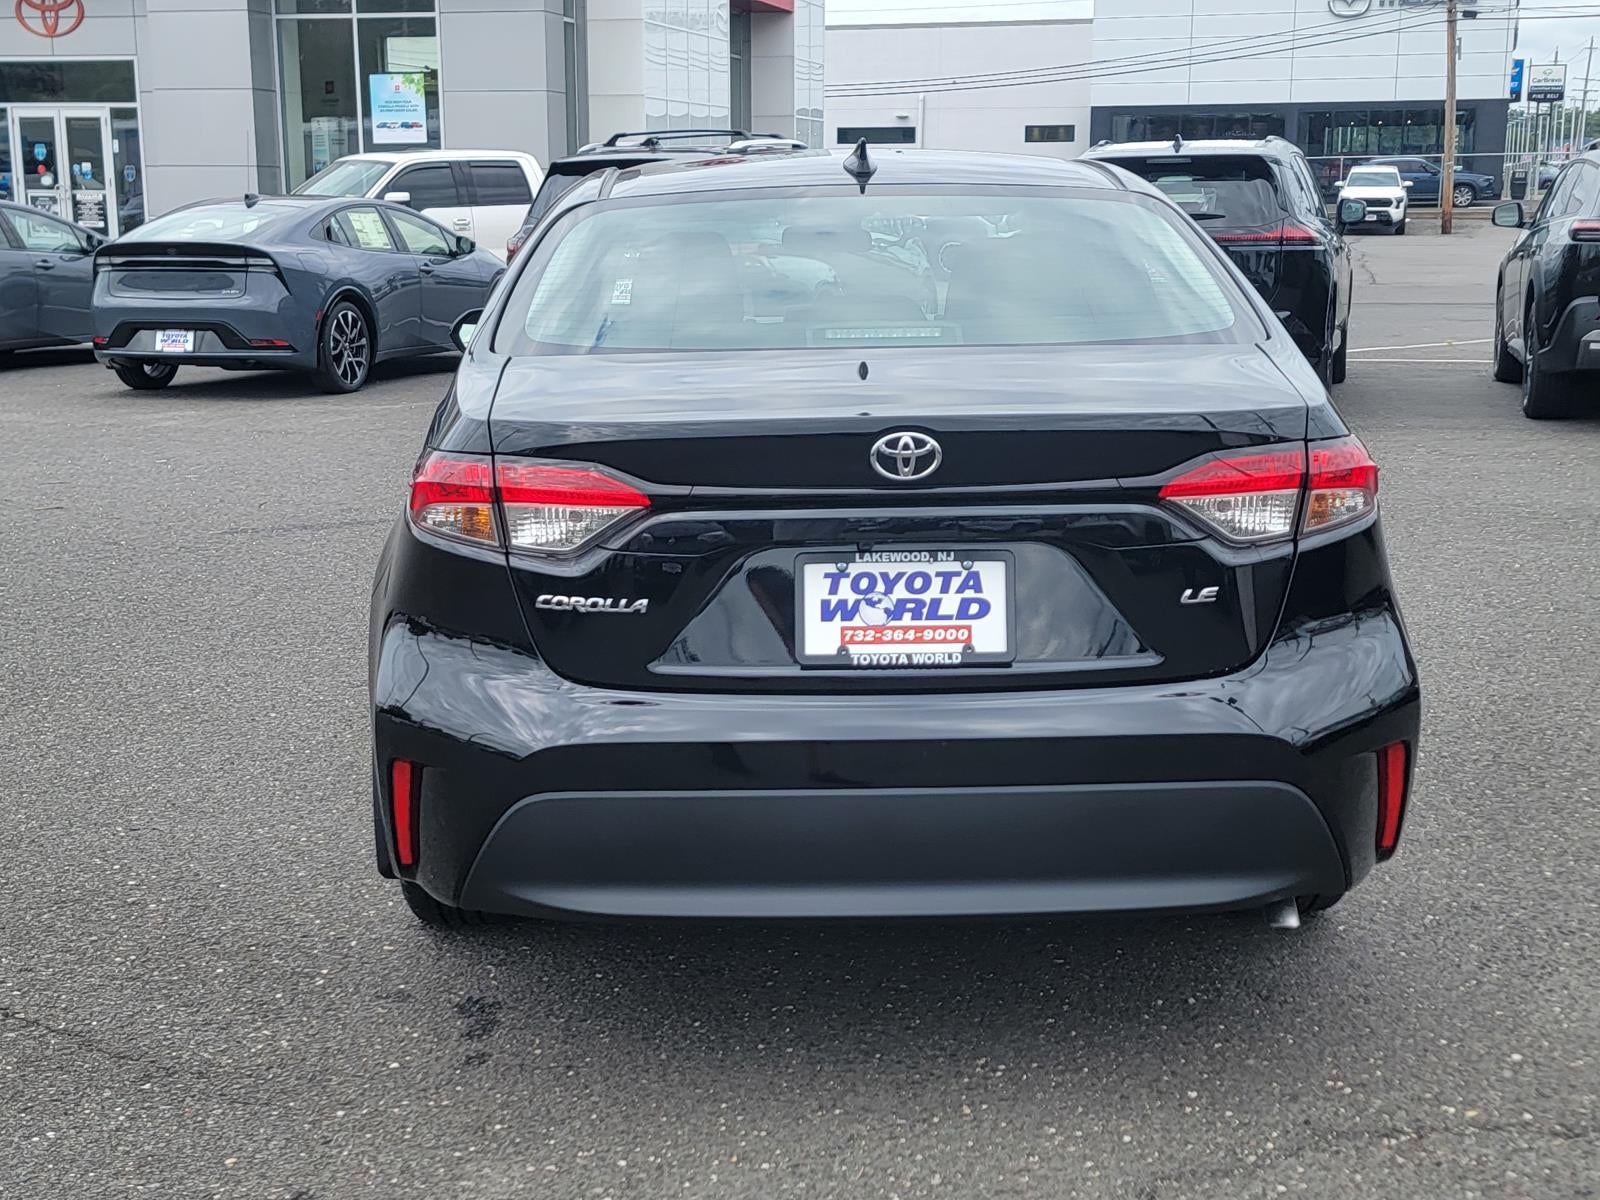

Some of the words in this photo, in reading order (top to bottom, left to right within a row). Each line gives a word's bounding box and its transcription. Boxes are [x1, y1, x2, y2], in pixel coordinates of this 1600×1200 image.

[855, 551, 934, 563] LAKEWOOD,
[937, 551, 955, 562] NJ
[823, 570, 984, 595] TOYOTA
[1180, 586, 1220, 604] LE
[535, 594, 649, 614] COROLLA
[843, 628, 969, 642] 732-364-9000
[852, 653, 909, 665] TOYOTA
[912, 652, 962, 664] WORLD
